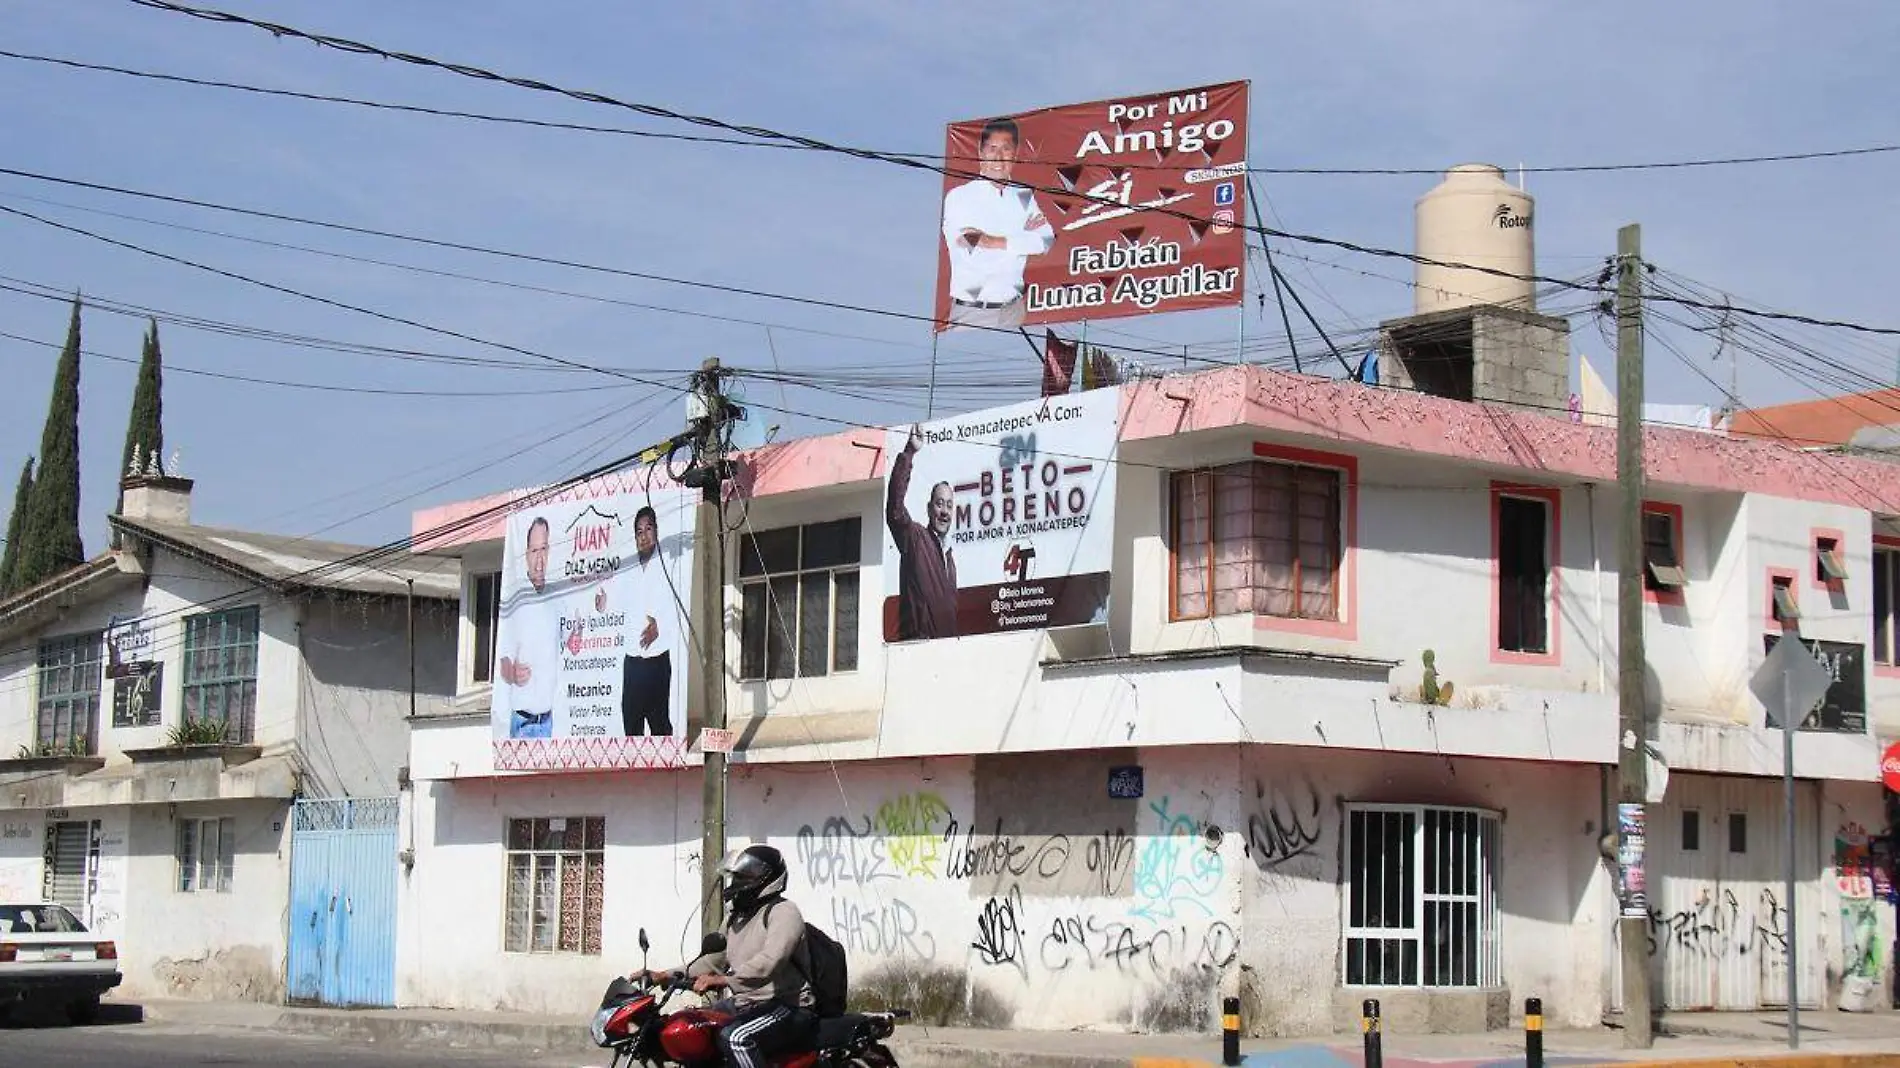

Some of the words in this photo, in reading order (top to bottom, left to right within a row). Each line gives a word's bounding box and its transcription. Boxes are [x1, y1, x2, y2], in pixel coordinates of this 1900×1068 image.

[1109, 102, 1158, 124] Por
[1168, 91, 1208, 116] Mi
[1076, 119, 1234, 159] Amigo
[1070, 237, 1180, 276] Fabián
[1027, 283, 1105, 312] Luna
[1112, 264, 1239, 307] Aguilar
[926, 429, 953, 444] Todo
[957, 417, 1033, 440] Xonacatepec
[1054, 405, 1082, 422] Con:
[980, 460, 1059, 497] BETO
[955, 486, 1086, 530] MORENO
[571, 523, 611, 558] JUAN
[977, 526, 1005, 541] AMOR
[1006, 525, 1014, 537] A
[1004, 544, 1036, 582] 4T
[587, 610, 625, 632] igualdad
[559, 640, 566, 656] y
[614, 632, 625, 647] de
[567, 681, 612, 698] Mecanico
